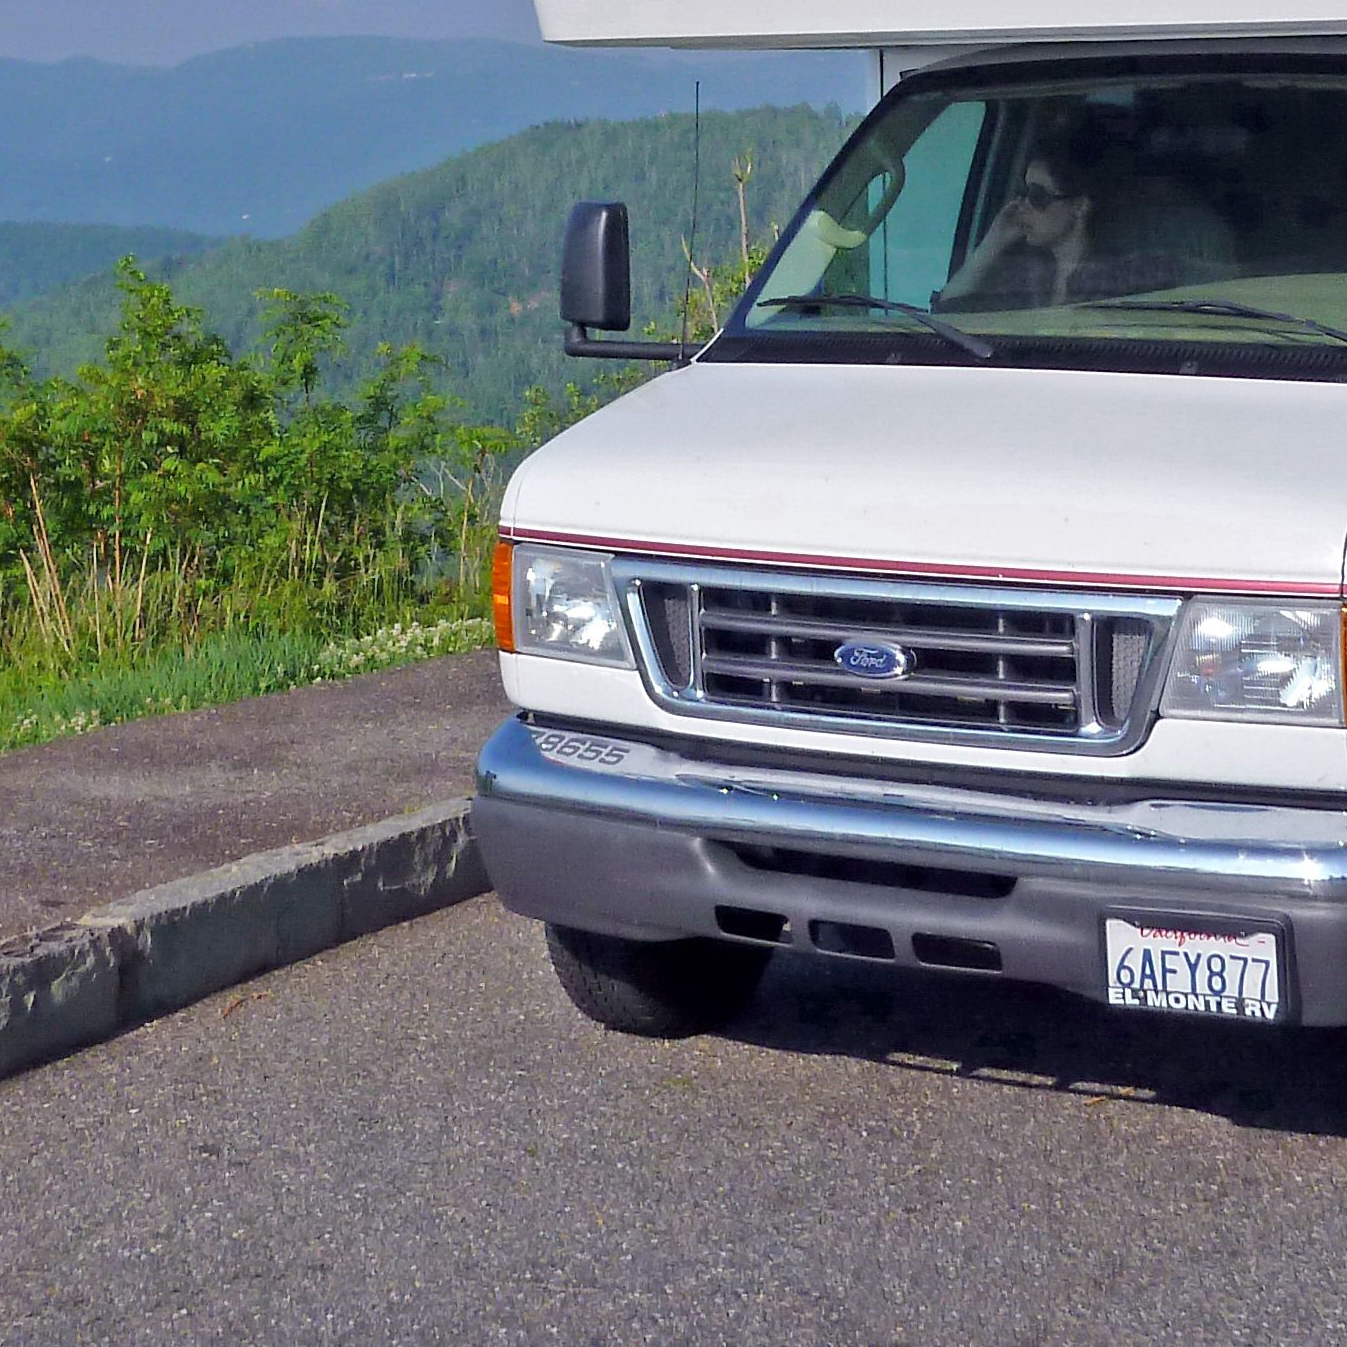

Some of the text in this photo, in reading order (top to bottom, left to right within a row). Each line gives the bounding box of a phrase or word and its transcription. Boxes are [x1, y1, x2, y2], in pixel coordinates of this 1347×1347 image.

[850, 648, 888, 668] Ford
[1116, 947, 1270, 1001] 6AFY877
[1108, 987, 1278, 1020] EL MONTE RV
